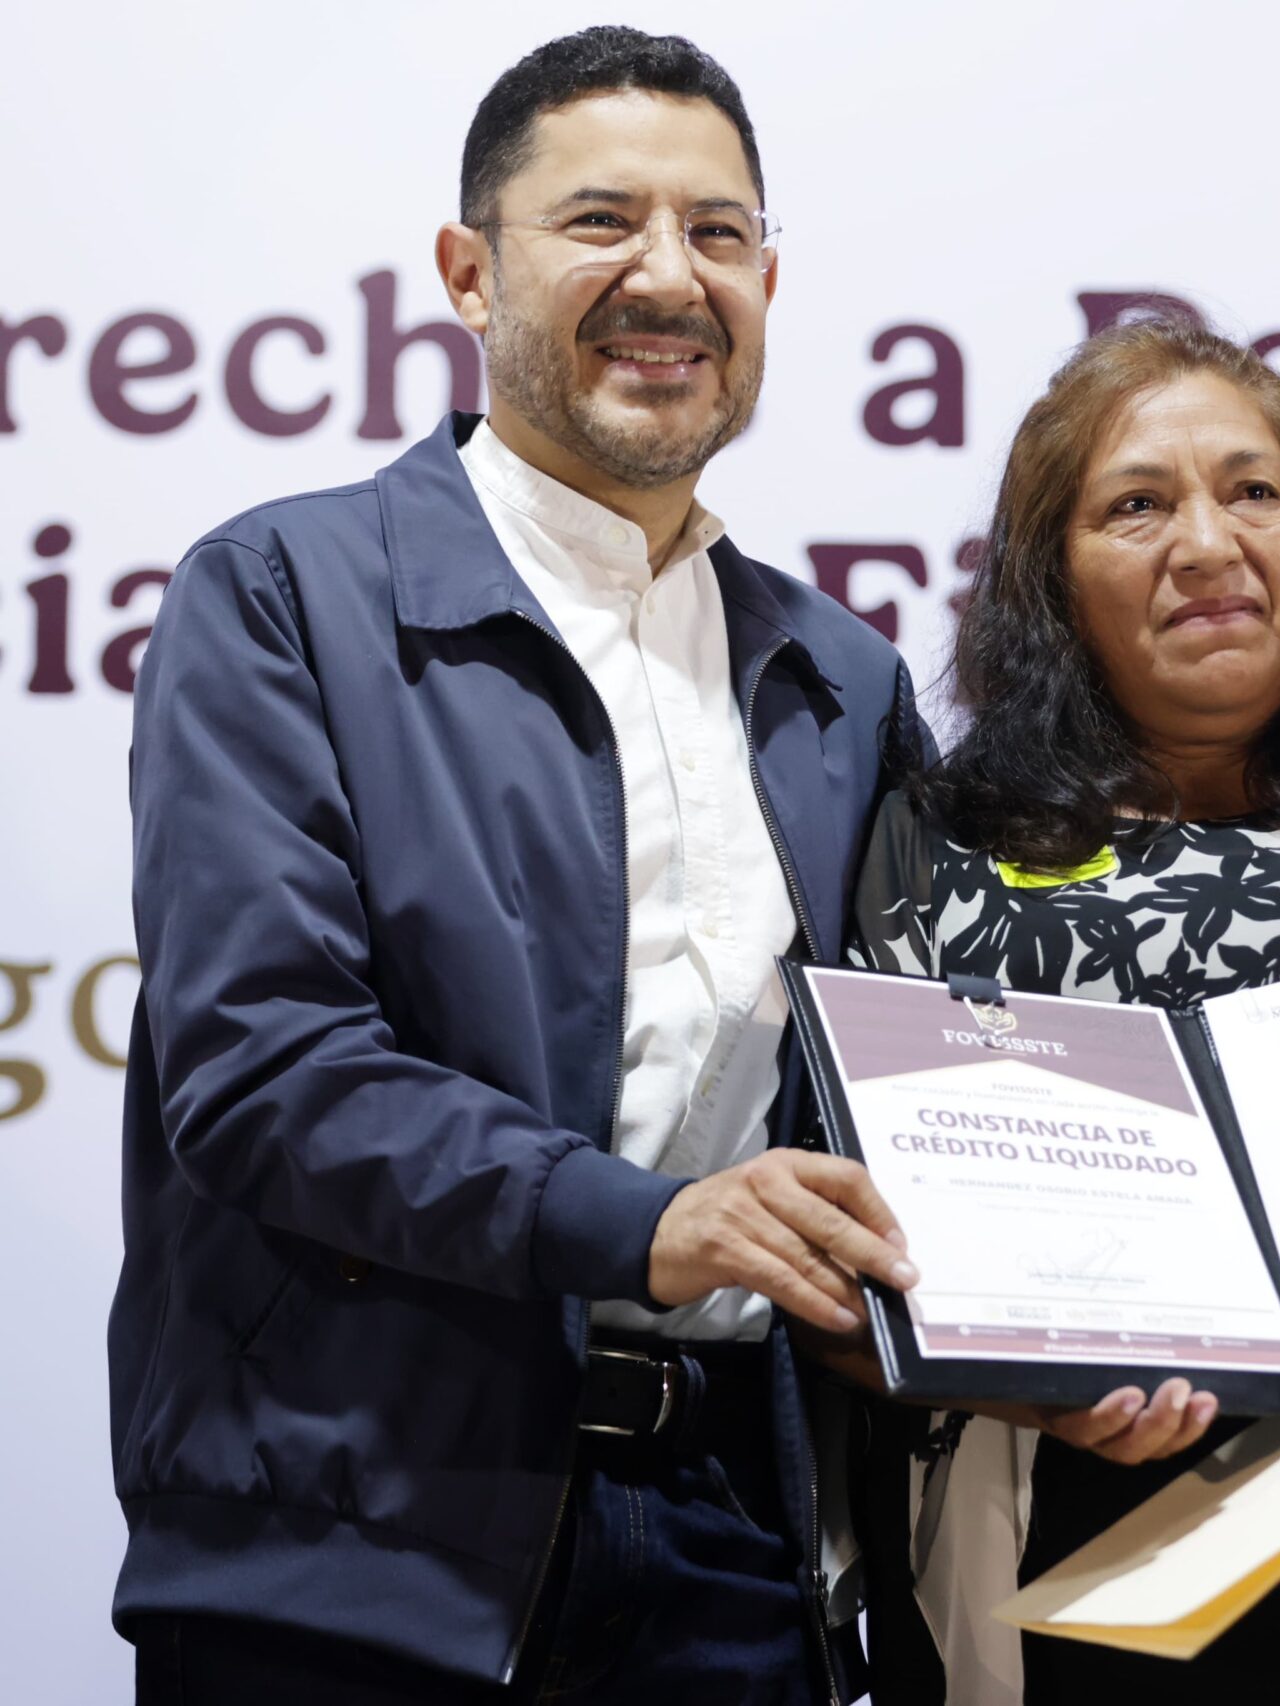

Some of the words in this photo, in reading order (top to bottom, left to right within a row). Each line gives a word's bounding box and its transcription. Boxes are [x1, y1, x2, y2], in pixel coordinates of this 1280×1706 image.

[862, 325, 966, 448] a
[917, 1107, 1113, 1144] CONSTANCIA
[1119, 1128, 1157, 1148] DE
[890, 1131, 1020, 1162] CRÉDITO
[1026, 1143, 1199, 1178] LIQUIDADO
